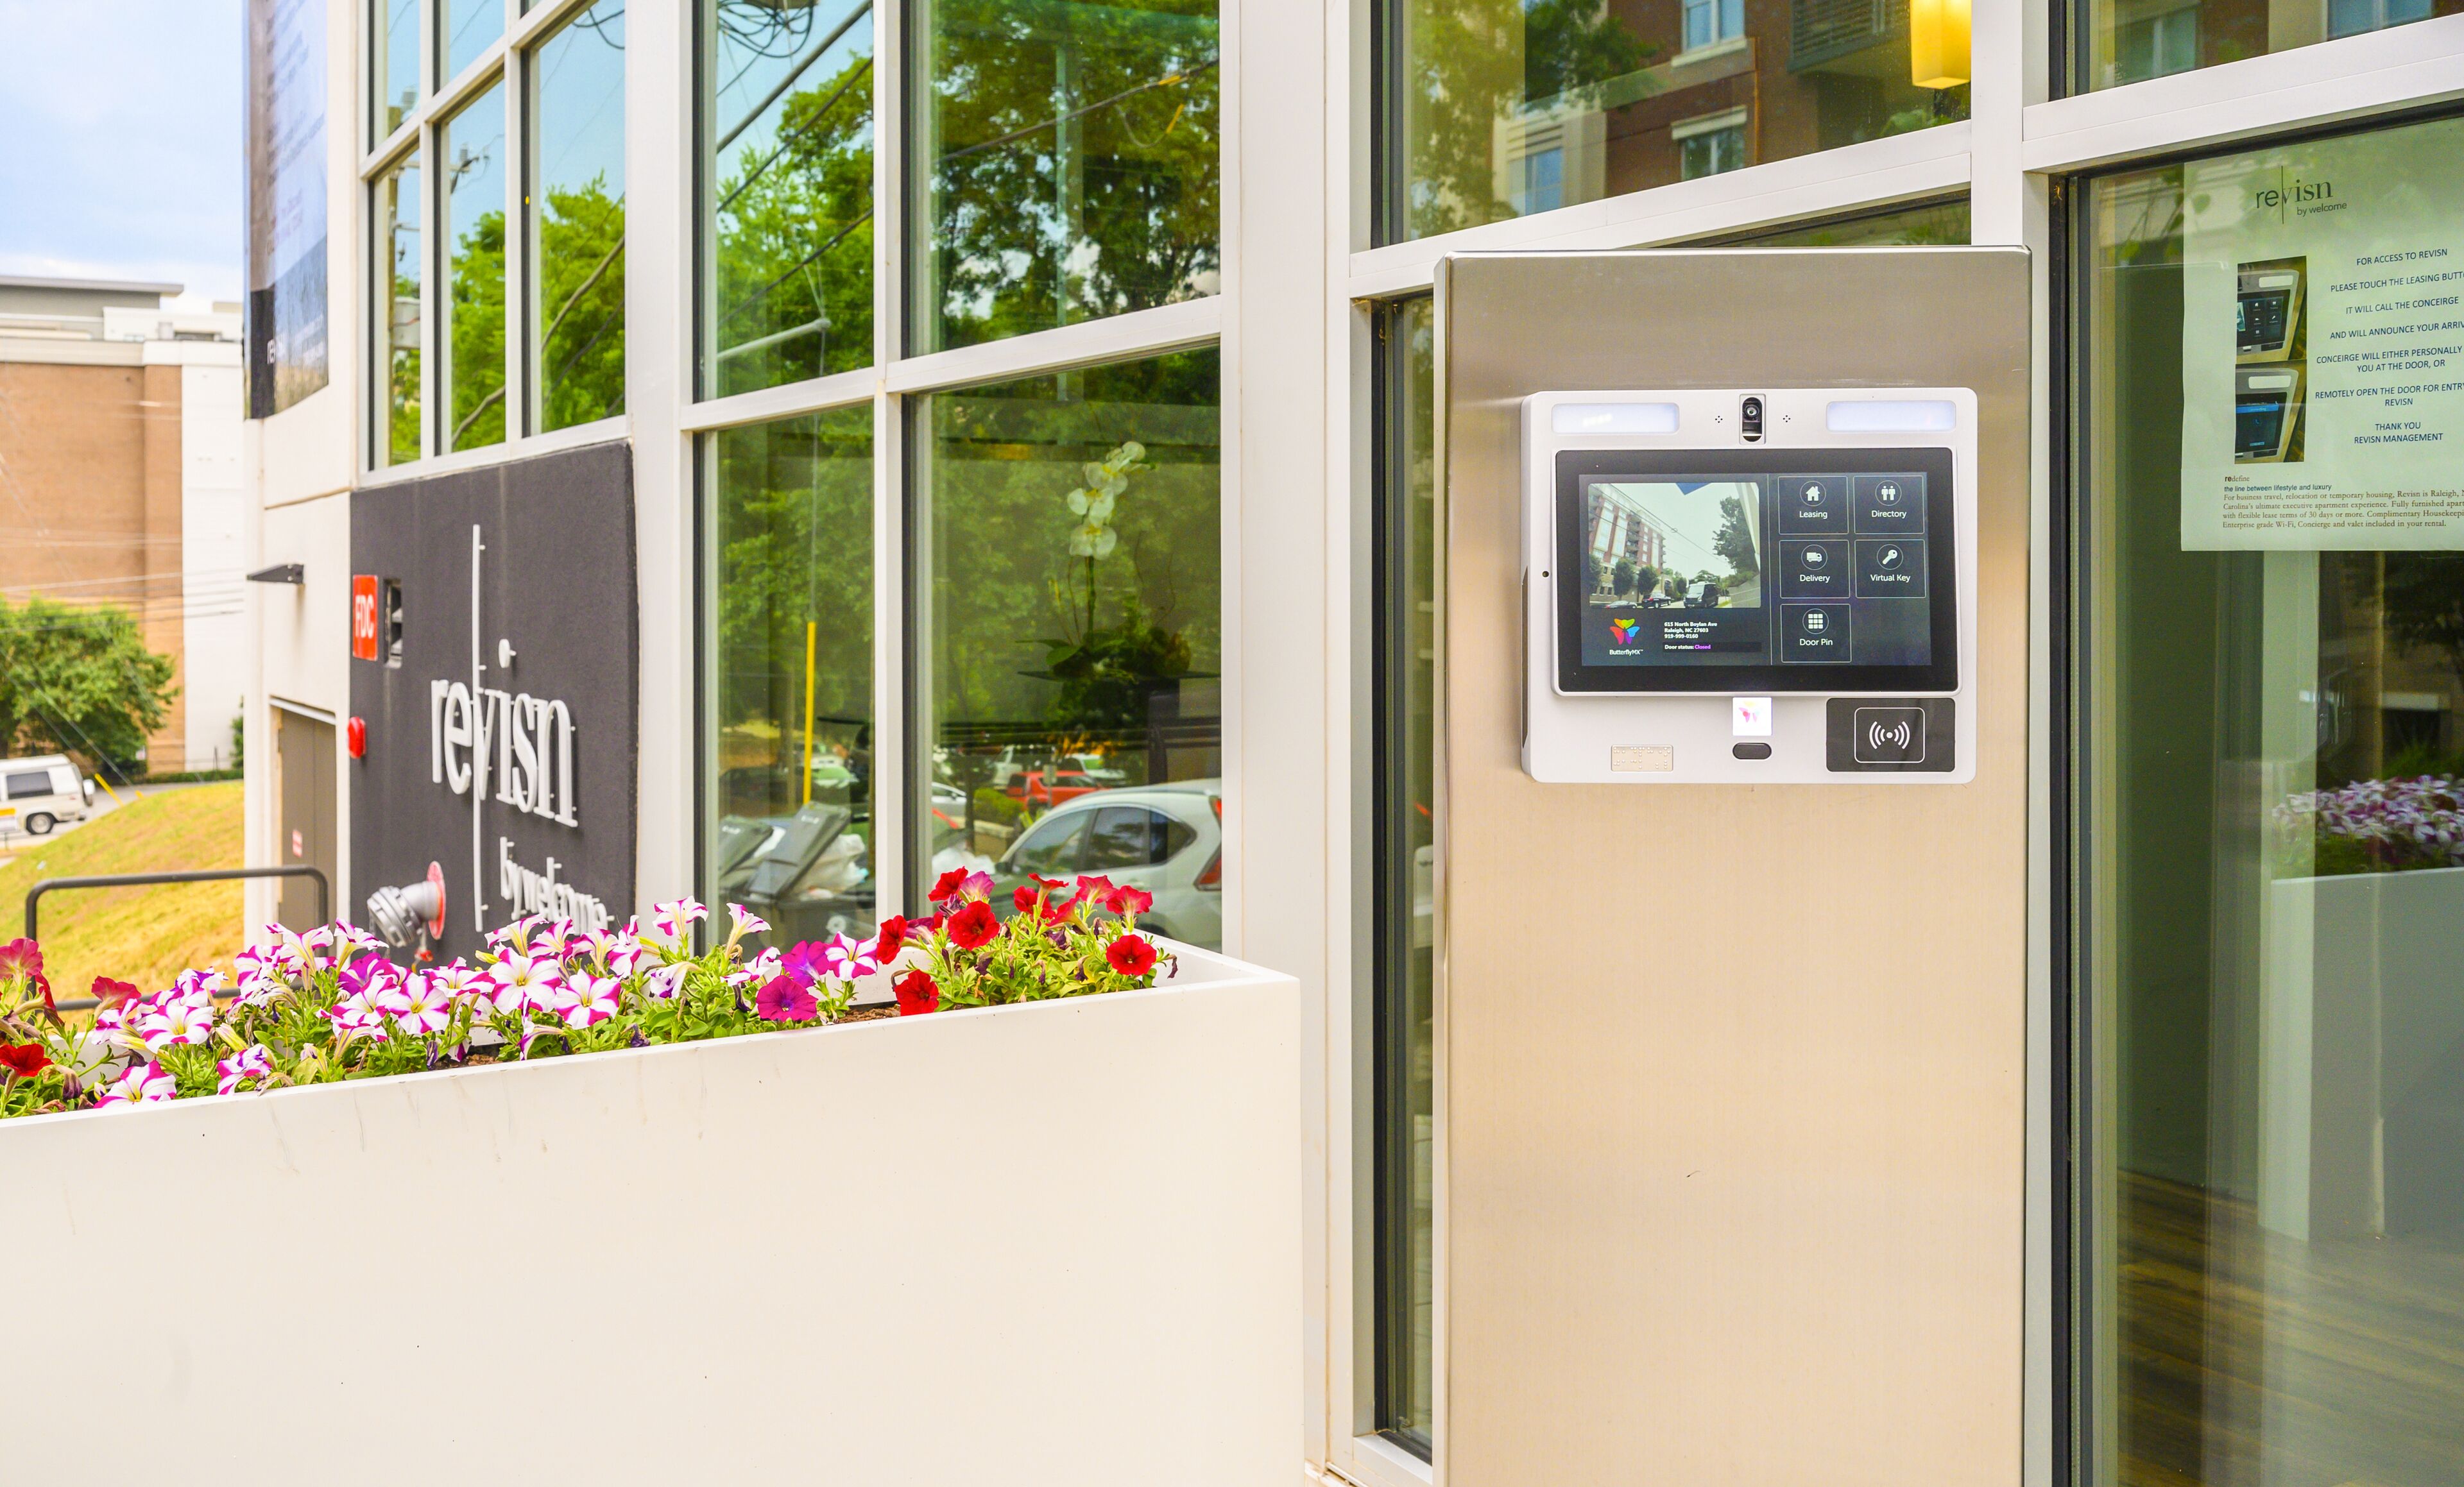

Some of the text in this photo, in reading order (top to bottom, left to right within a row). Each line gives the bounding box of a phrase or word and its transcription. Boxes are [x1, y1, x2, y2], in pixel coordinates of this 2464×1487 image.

[2256, 179, 2334, 208] revisn
[2297, 203, 2347, 217] by welcome
[2356, 248, 2448, 266] FOR ACCESS TO REVISN
[2331, 271, 2464, 292] PLEASE TOUCH THE LEASING BUTT
[2354, 304, 2373, 313] WILL
[2375, 302, 2393, 312] CALL
[2395, 301, 2410, 309] THE
[2412, 296, 2459, 308] CONCEIRGE
[2330, 331, 2347, 339] AND
[2348, 328, 2366, 338] WILL
[2368, 325, 2415, 336] ANNOUNCE
[2417, 323, 2439, 332] YOUR
[2316, 346, 2463, 364] CONCEIRGE WILL EITHER PERSONALLY
[2357, 364, 2374, 373] YOU
[2405, 360, 2431, 370] DOOR,
[2315, 389, 2354, 399] REMOTELY
[2356, 388, 2378, 396] OPEN
[2397, 386, 2421, 394] DOOR
[2423, 384, 2439, 393] FOR
[2442, 382, 2464, 391] ENTR
[2384, 398, 2413, 406] REVISN
[2375, 421, 2421, 431] THANK YOU
[2354, 433, 2443, 444] REVISN MANAGEMENT
[2329, 492, 2364, 500] temporary
[2366, 491, 2395, 500] housing,
[2431, 489, 2459, 498] Raleigh,
[2314, 502, 2348, 511] apartment
[2391, 500, 2409, 509] Fully
[1799, 511, 1828, 520] Leasing
[1871, 510, 1907, 519] Directory
[2366, 510, 2421, 519] Complimentary
[2223, 522, 2255, 530] Enterprise
[2298, 520, 2331, 529] Concierge
[1799, 574, 1830, 583] Delivery
[1897, 574, 1911, 583] Key
[355, 594, 375, 639] FDC
